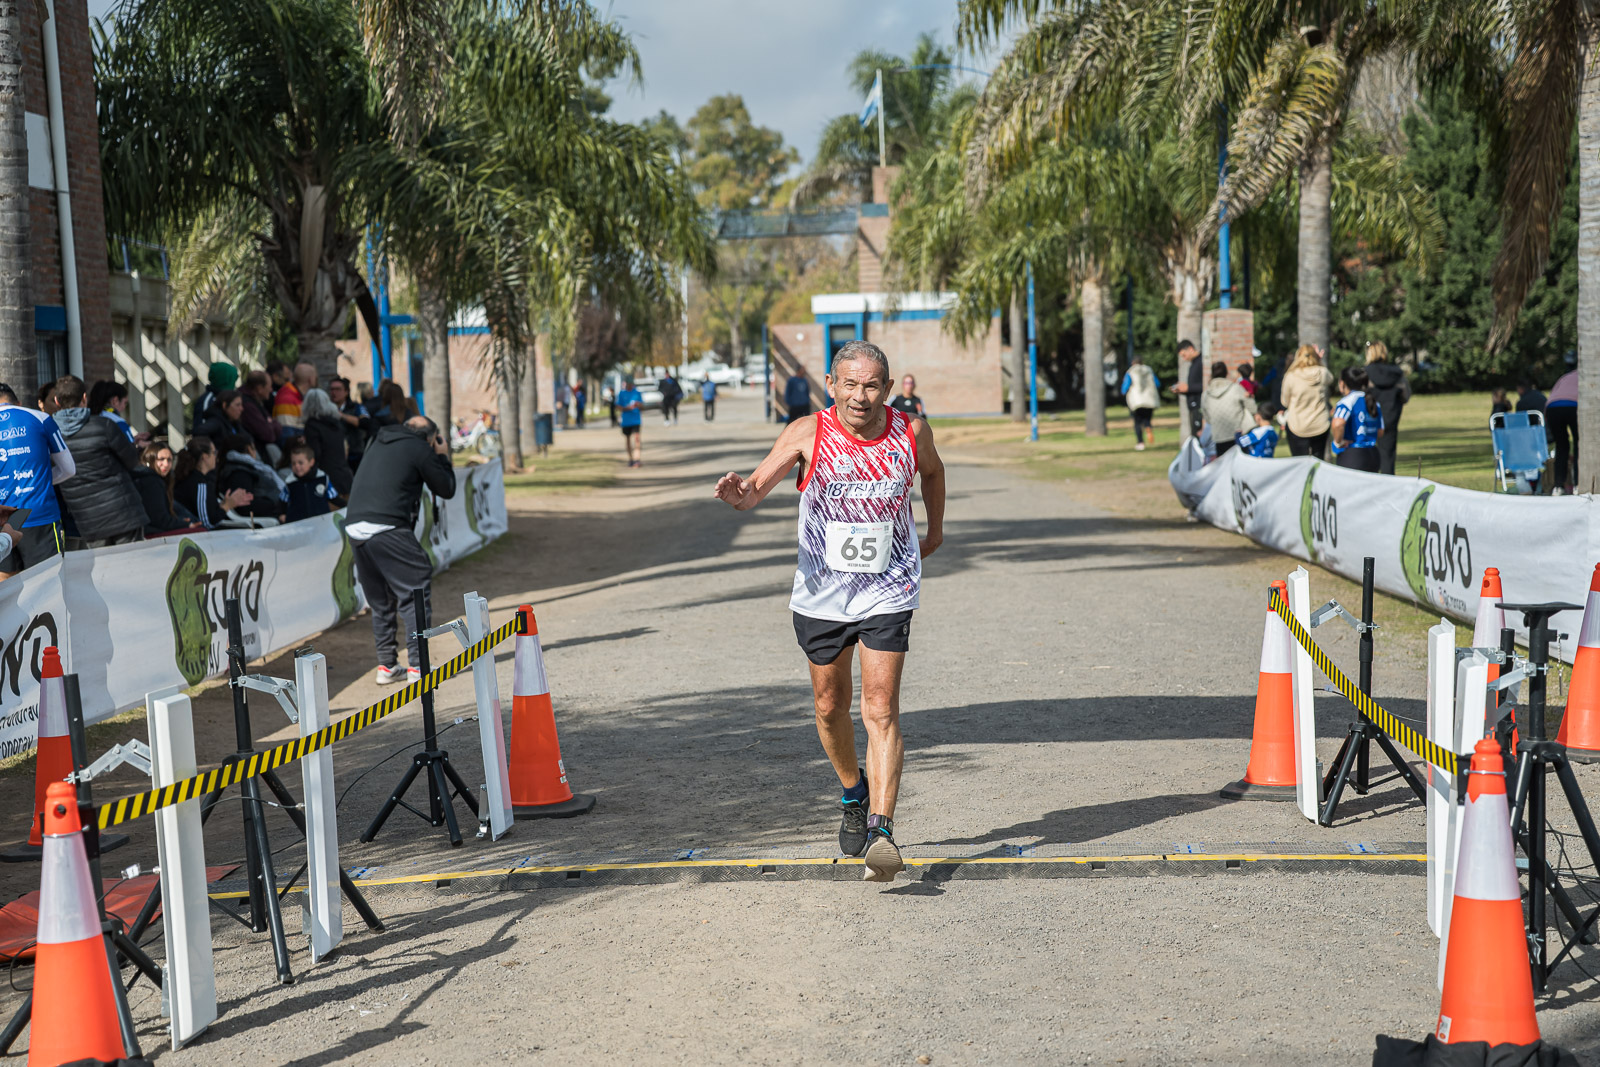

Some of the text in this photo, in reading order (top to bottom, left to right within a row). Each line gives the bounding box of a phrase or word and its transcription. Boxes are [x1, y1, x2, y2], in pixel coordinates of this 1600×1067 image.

[0, 425, 27, 441] DAR
[848, 480, 904, 493] TRIATLON
[841, 537, 877, 561] 65
[0, 703, 39, 729] ronorav
[0, 734, 34, 759] onorav
